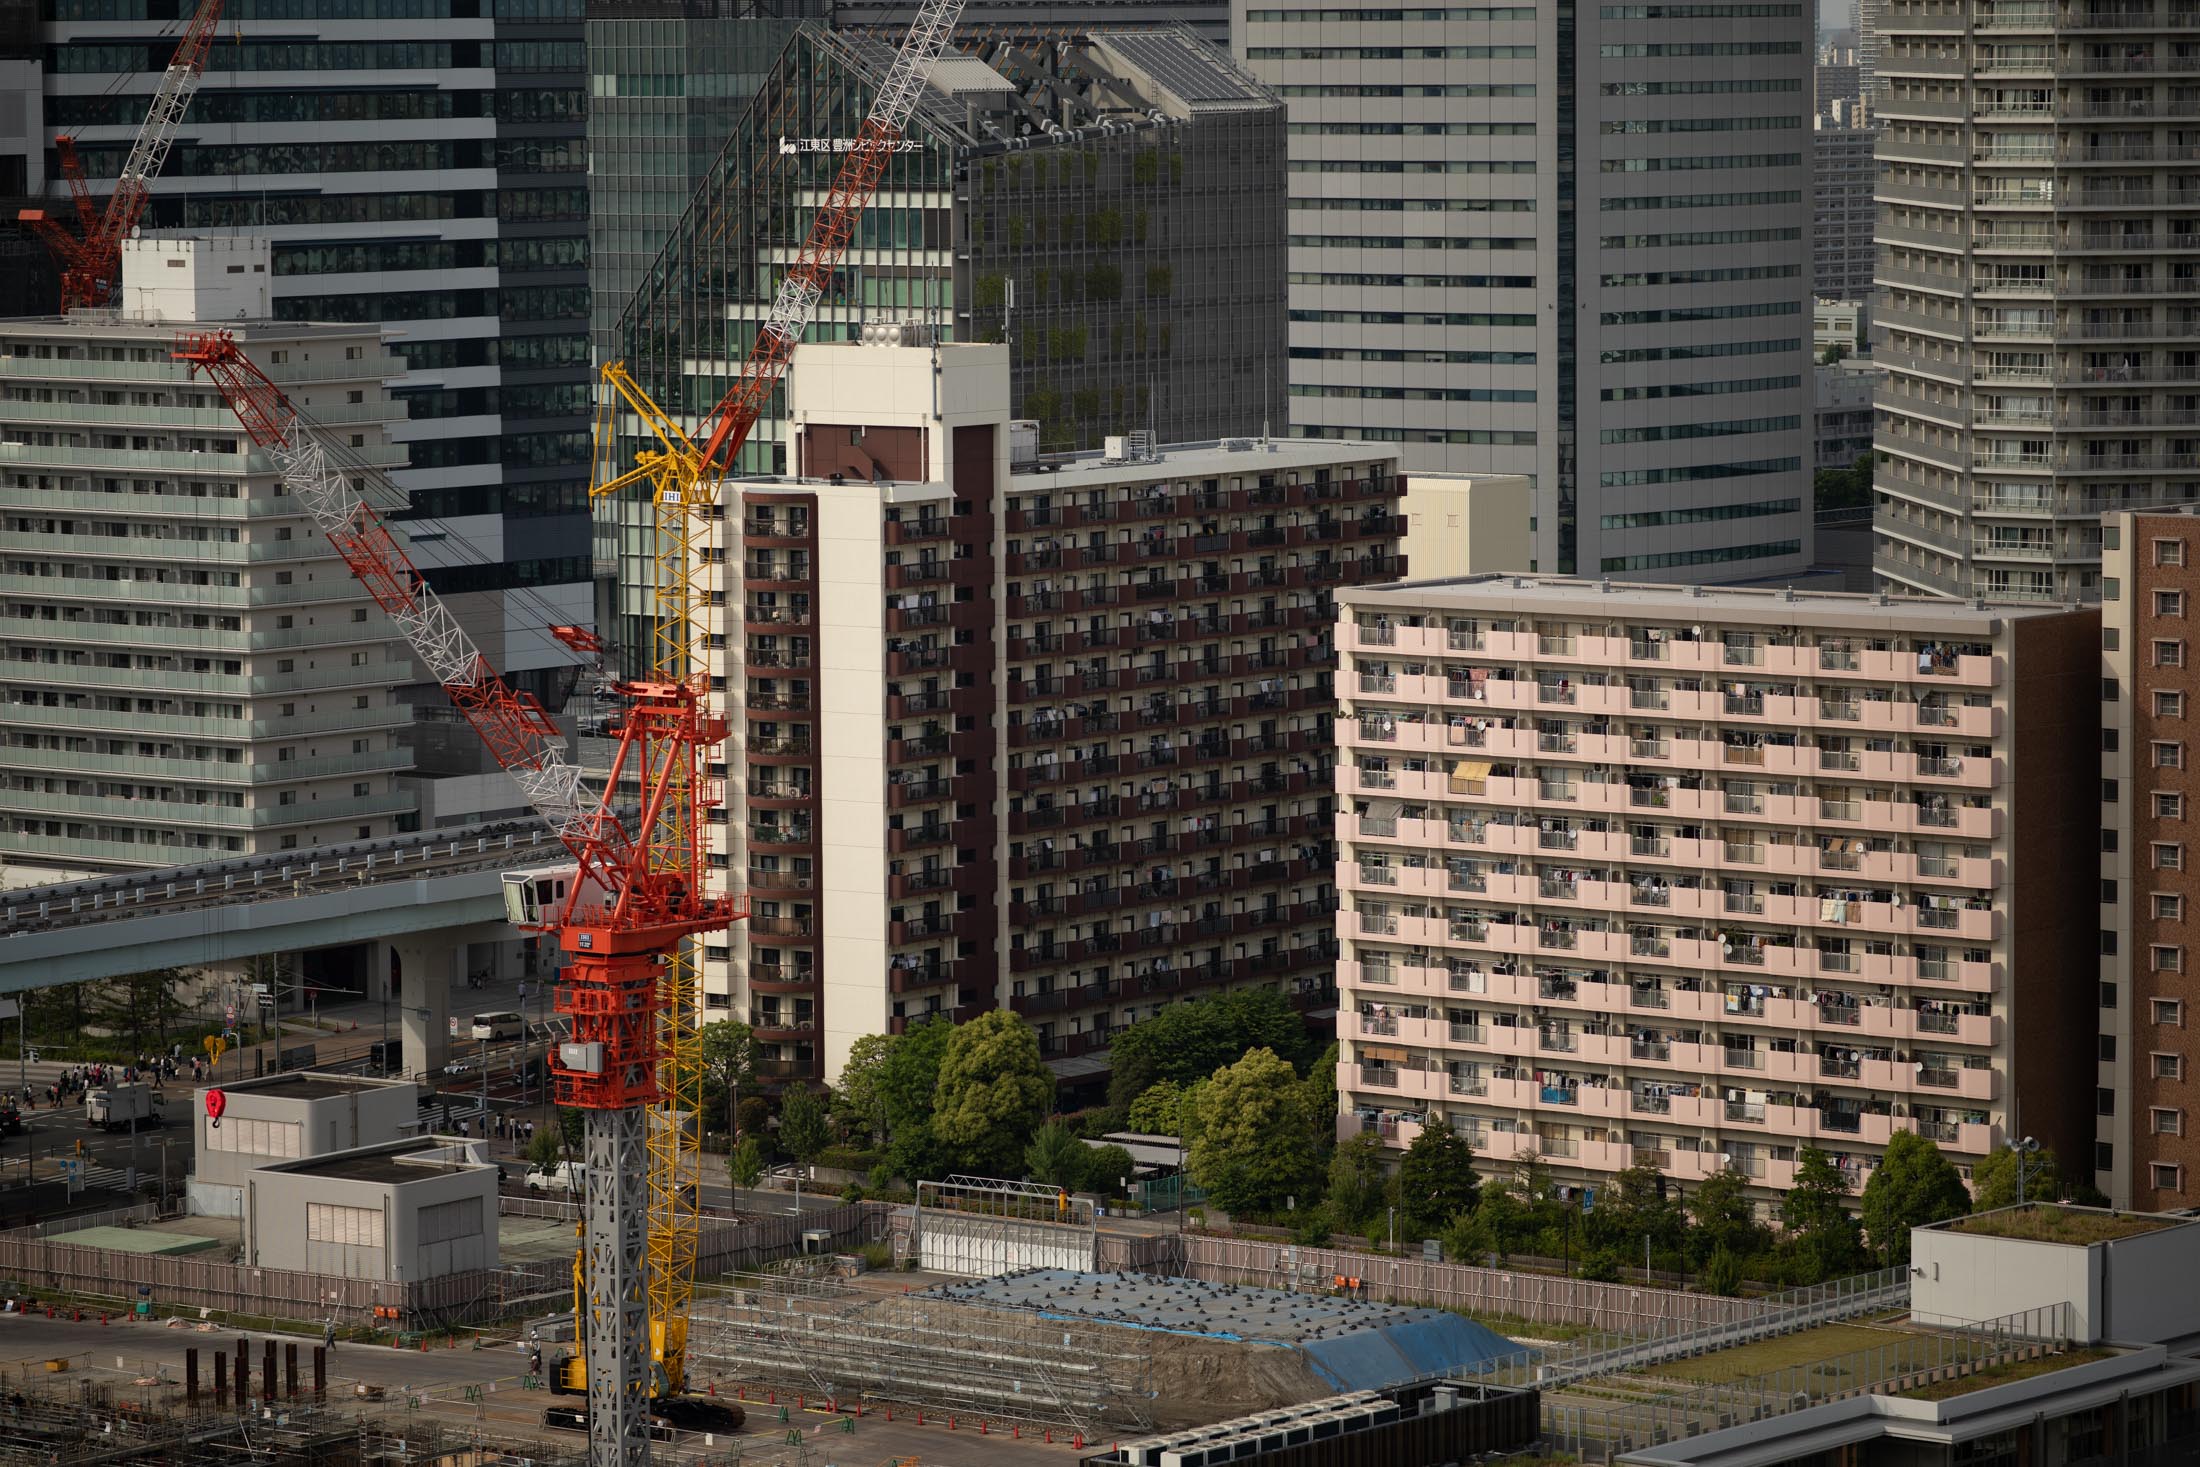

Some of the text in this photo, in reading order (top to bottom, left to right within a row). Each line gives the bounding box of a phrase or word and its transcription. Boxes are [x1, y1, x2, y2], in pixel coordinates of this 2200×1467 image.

[800, 138, 830, 152] 江東区
[664, 492, 679, 502] IHI
